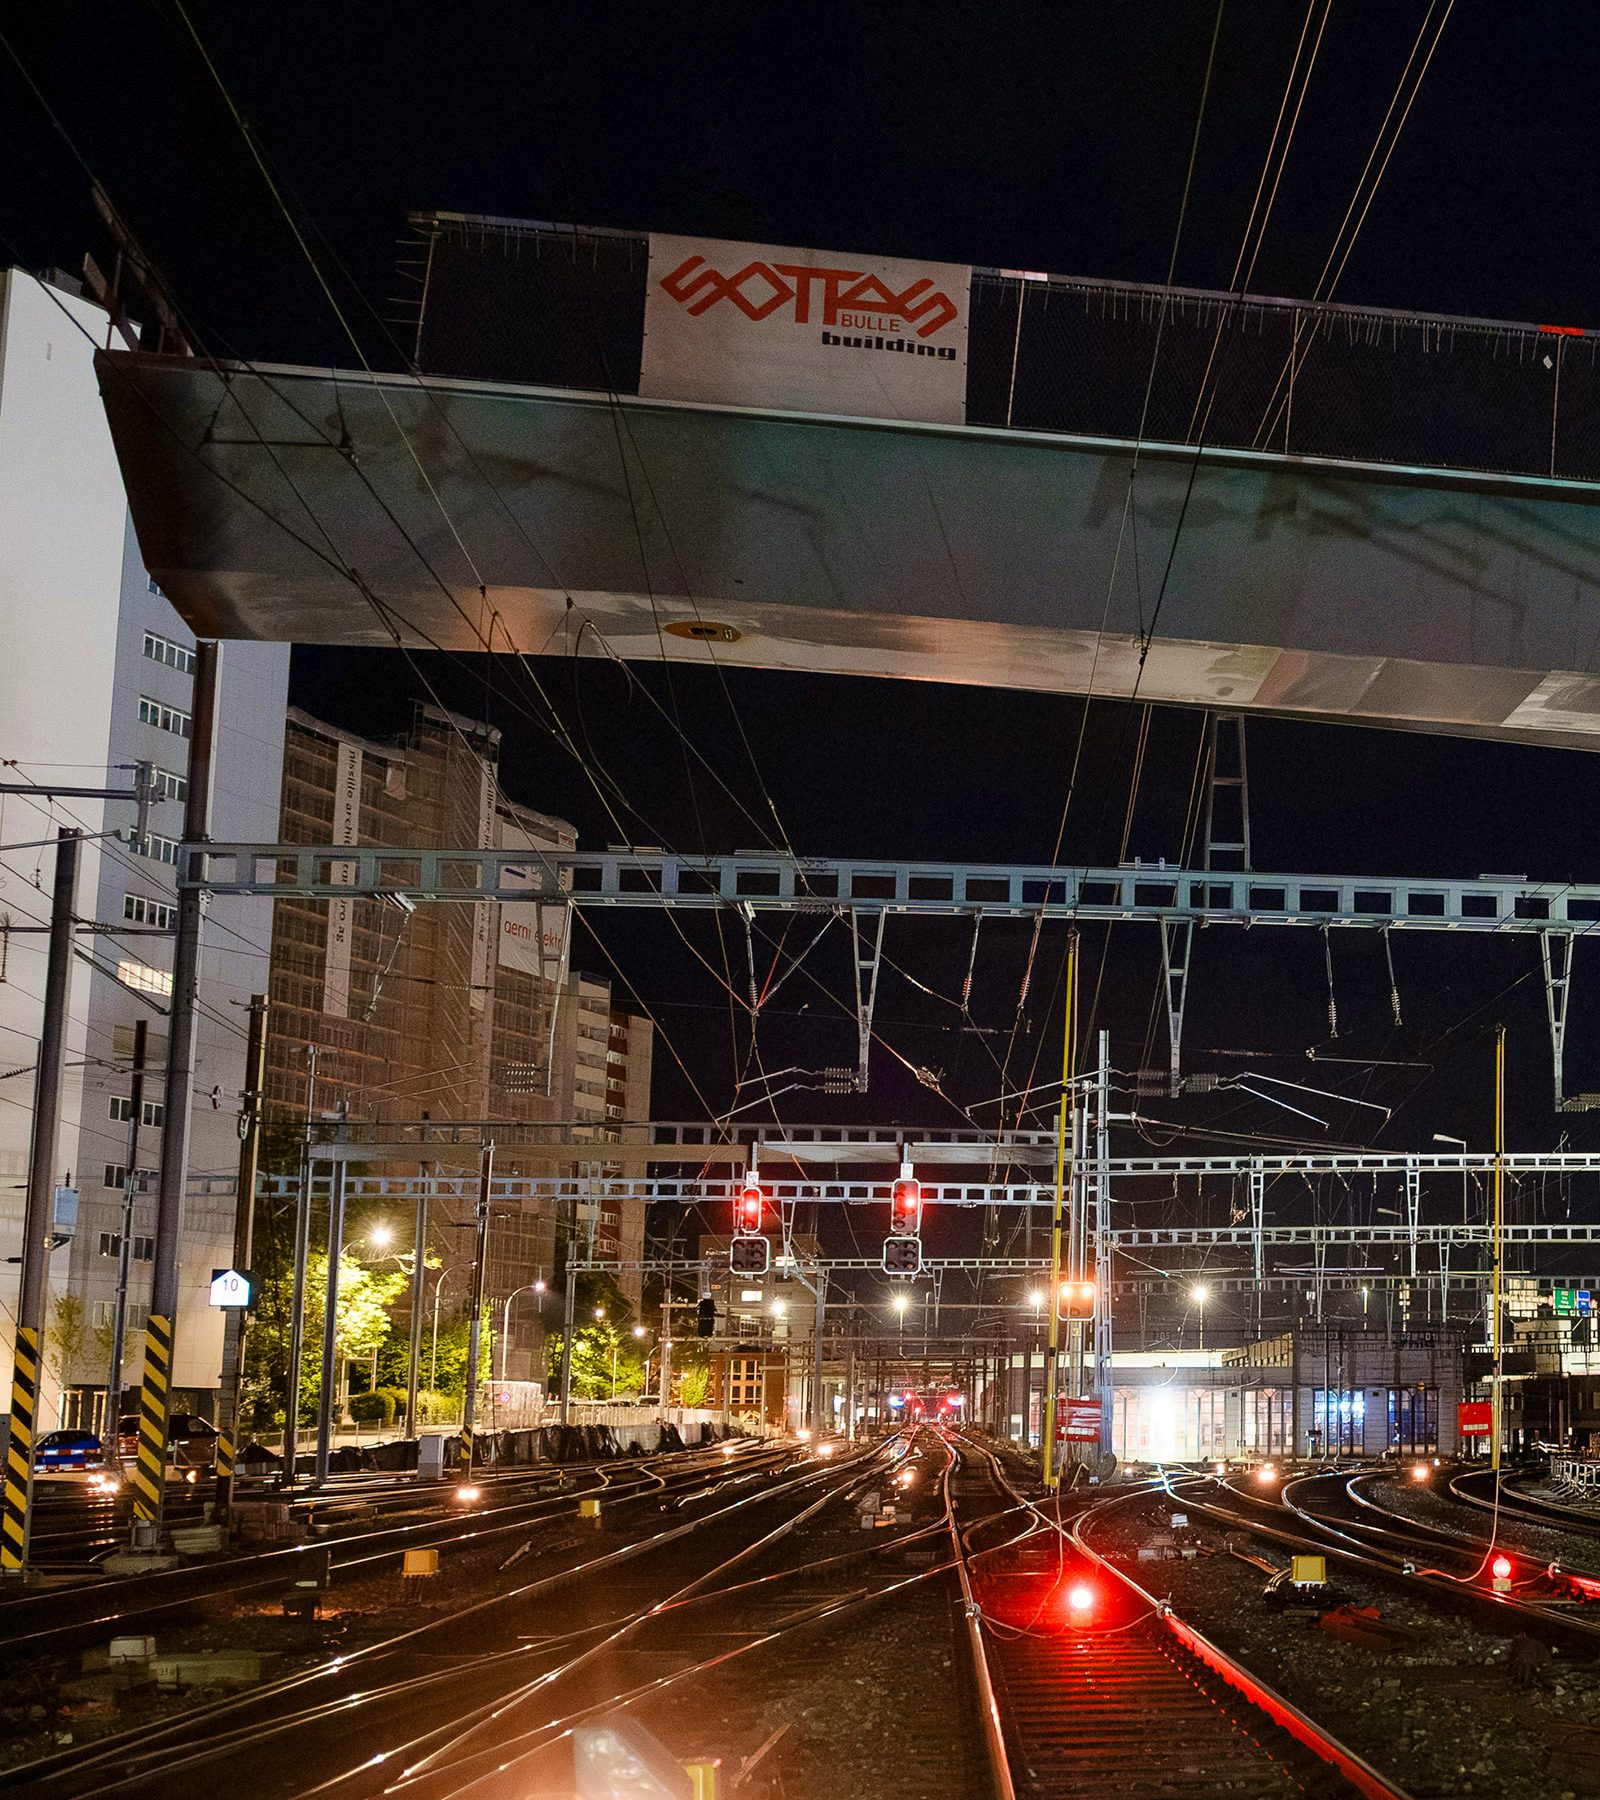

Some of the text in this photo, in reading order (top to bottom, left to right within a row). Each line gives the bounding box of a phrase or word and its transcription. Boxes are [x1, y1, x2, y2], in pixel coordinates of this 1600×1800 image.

[660, 255, 958, 338] SOTTAS
[841, 313, 901, 332] BULLE
[822, 331, 956, 360] building
[504, 919, 531, 941] aerni
[223, 1278, 238, 1291] 10
